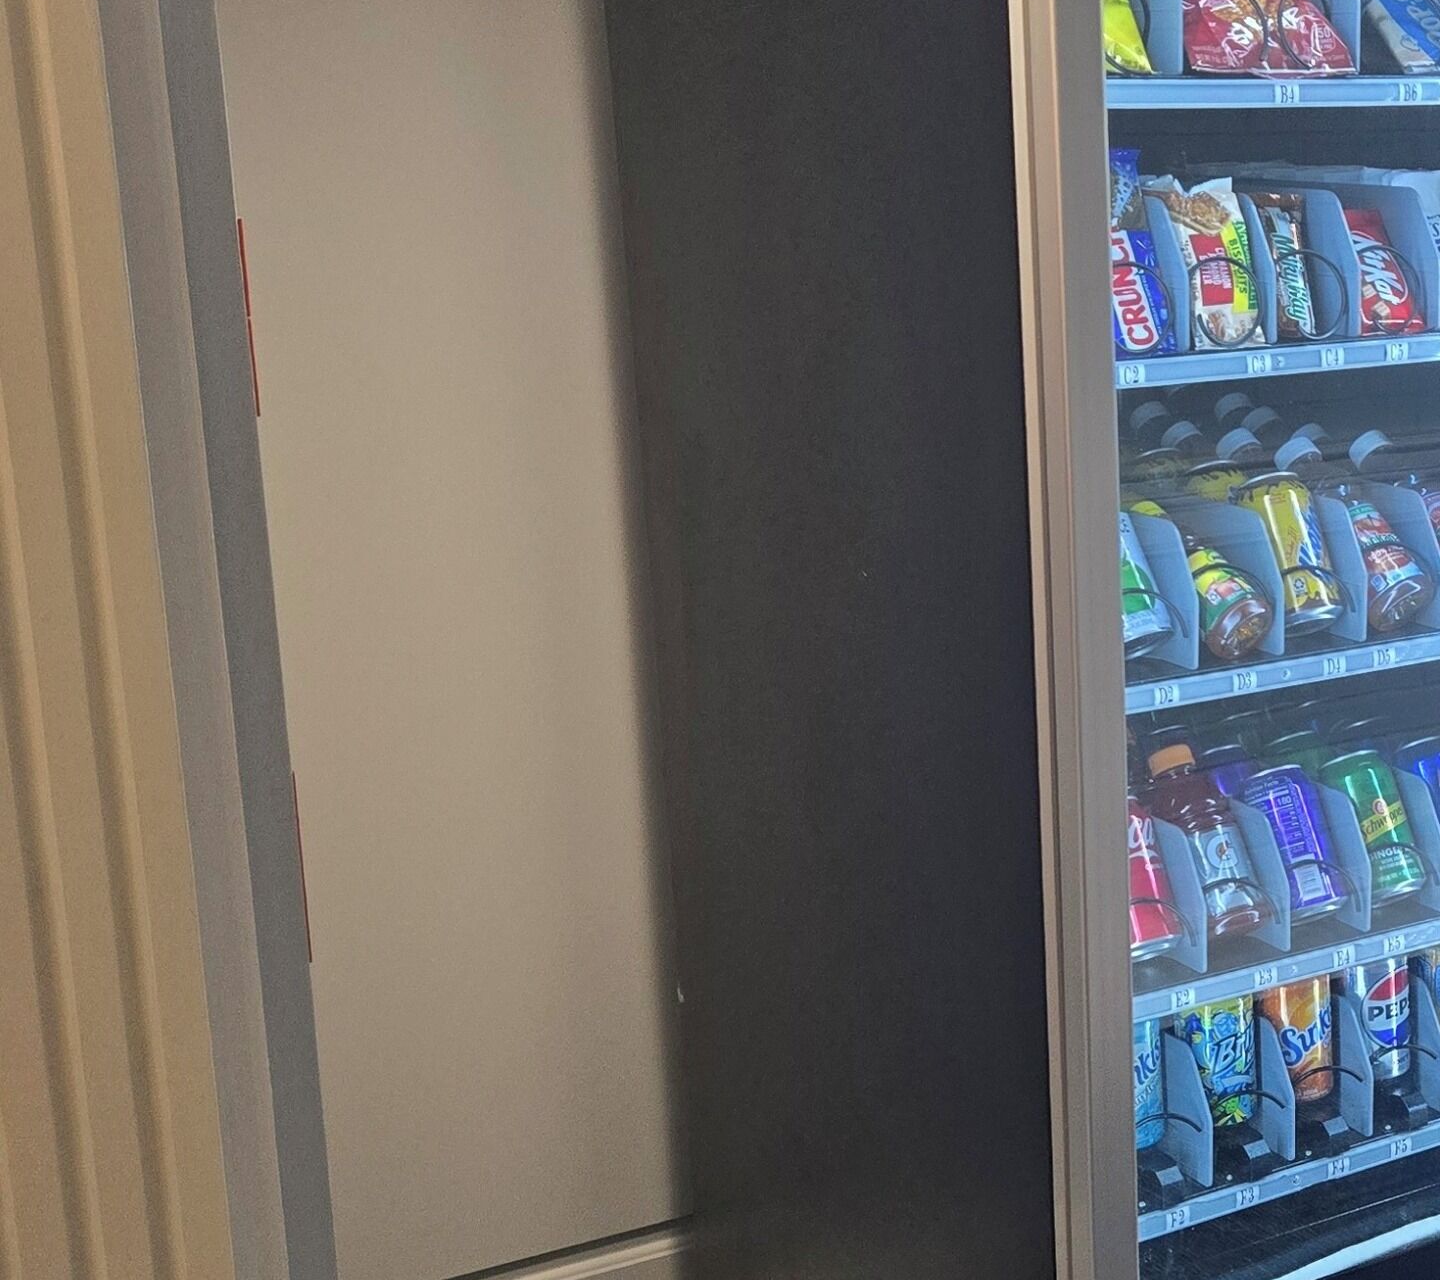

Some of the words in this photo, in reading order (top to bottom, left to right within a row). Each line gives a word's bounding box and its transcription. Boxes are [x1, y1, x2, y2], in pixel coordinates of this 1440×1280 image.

[1280, 85, 1295, 104] B4
[1403, 84, 1418, 101] B6
[1251, 355, 1267, 372] C3
[1325, 349, 1339, 367] C4
[1123, 366, 1139, 384] C2
[1327, 657, 1341, 674] D4
[1377, 649, 1390, 665] D5
[1236, 673, 1251, 691] D3
[1158, 686, 1173, 704] D2
[1387, 935, 1401, 951] E5
[1336, 949, 1351, 966] E4
[1258, 967, 1273, 986] E3
[1175, 990, 1191, 1008] E2
[1394, 1140, 1408, 1155] F5
[1332, 1158, 1346, 1176] F4
[1239, 1186, 1254, 1206] F3
[1170, 1210, 1185, 1228] F2
